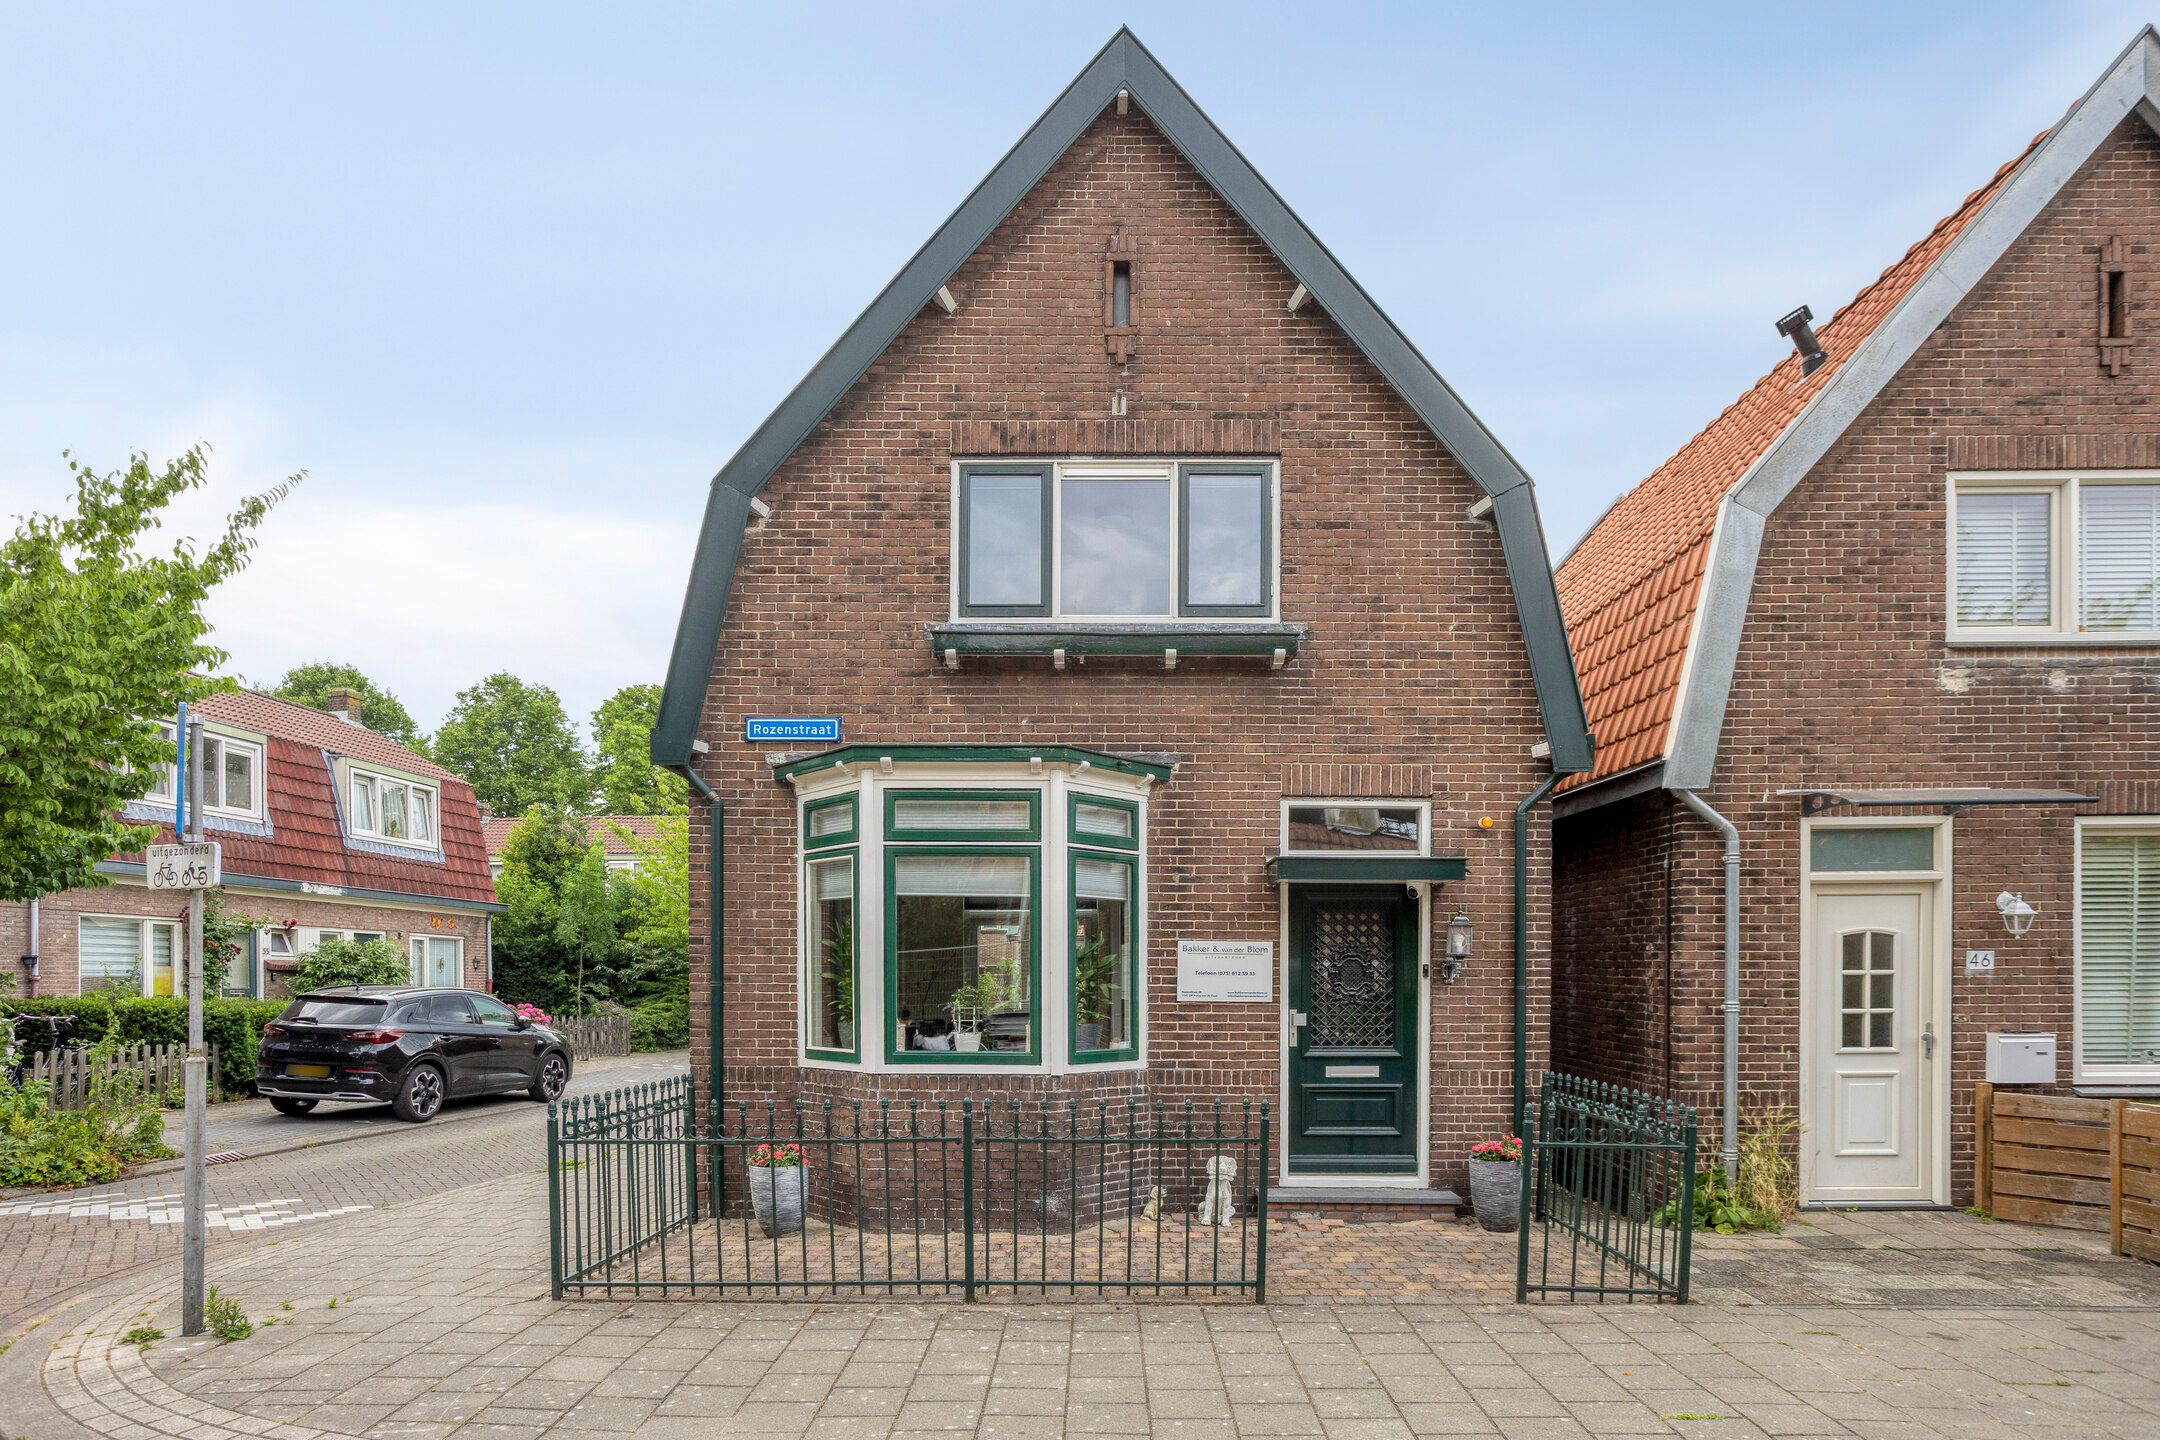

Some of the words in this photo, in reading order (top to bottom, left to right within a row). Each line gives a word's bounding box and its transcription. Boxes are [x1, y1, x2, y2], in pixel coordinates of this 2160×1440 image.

[753, 724, 832, 735] Rozenstraat
[152, 846, 209, 859] uitgezonderd
[1182, 944, 1210, 953] Bakker
[1247, 945, 1269, 953] Blom
[1970, 953, 1991, 967] 46
